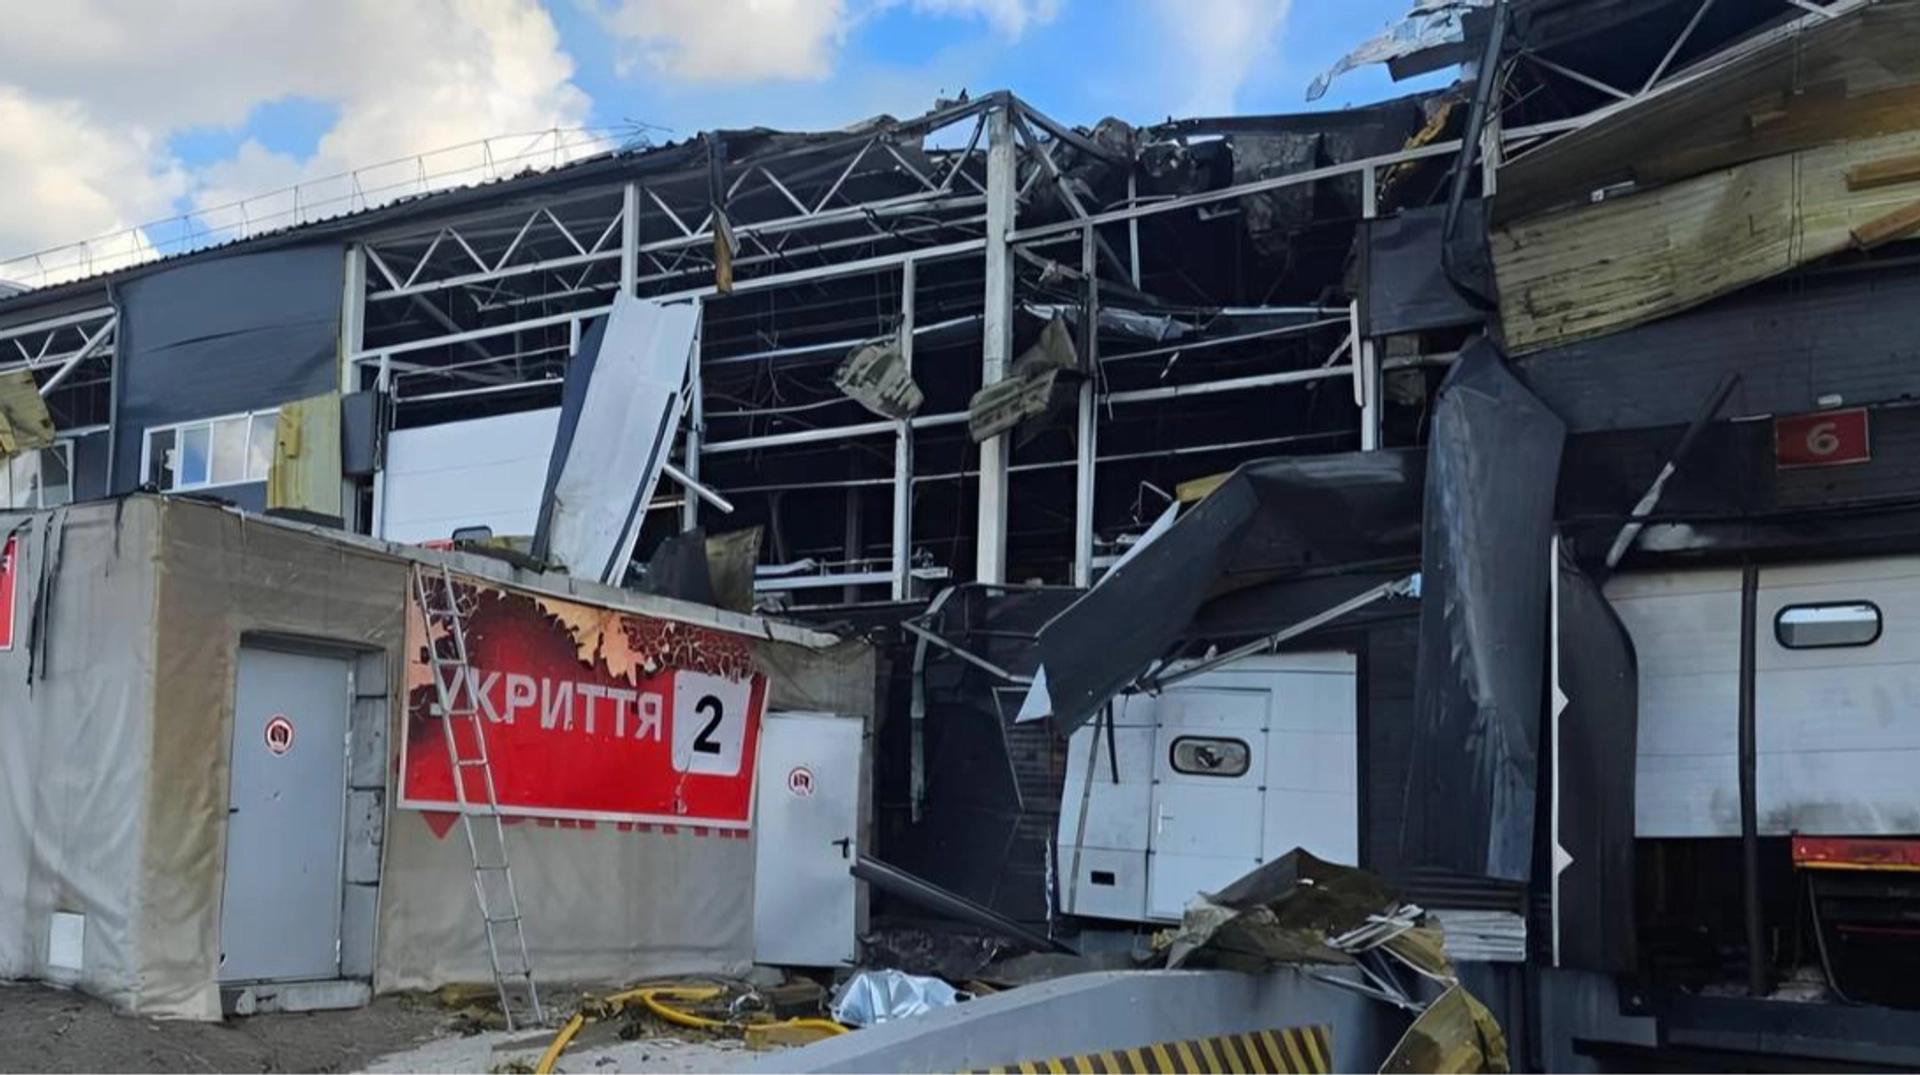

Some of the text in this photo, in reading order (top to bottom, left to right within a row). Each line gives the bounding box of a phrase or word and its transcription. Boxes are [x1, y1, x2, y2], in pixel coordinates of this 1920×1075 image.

[1806, 422, 1839, 455] 6
[430, 665, 723, 755] УКРИТТЯ 2
